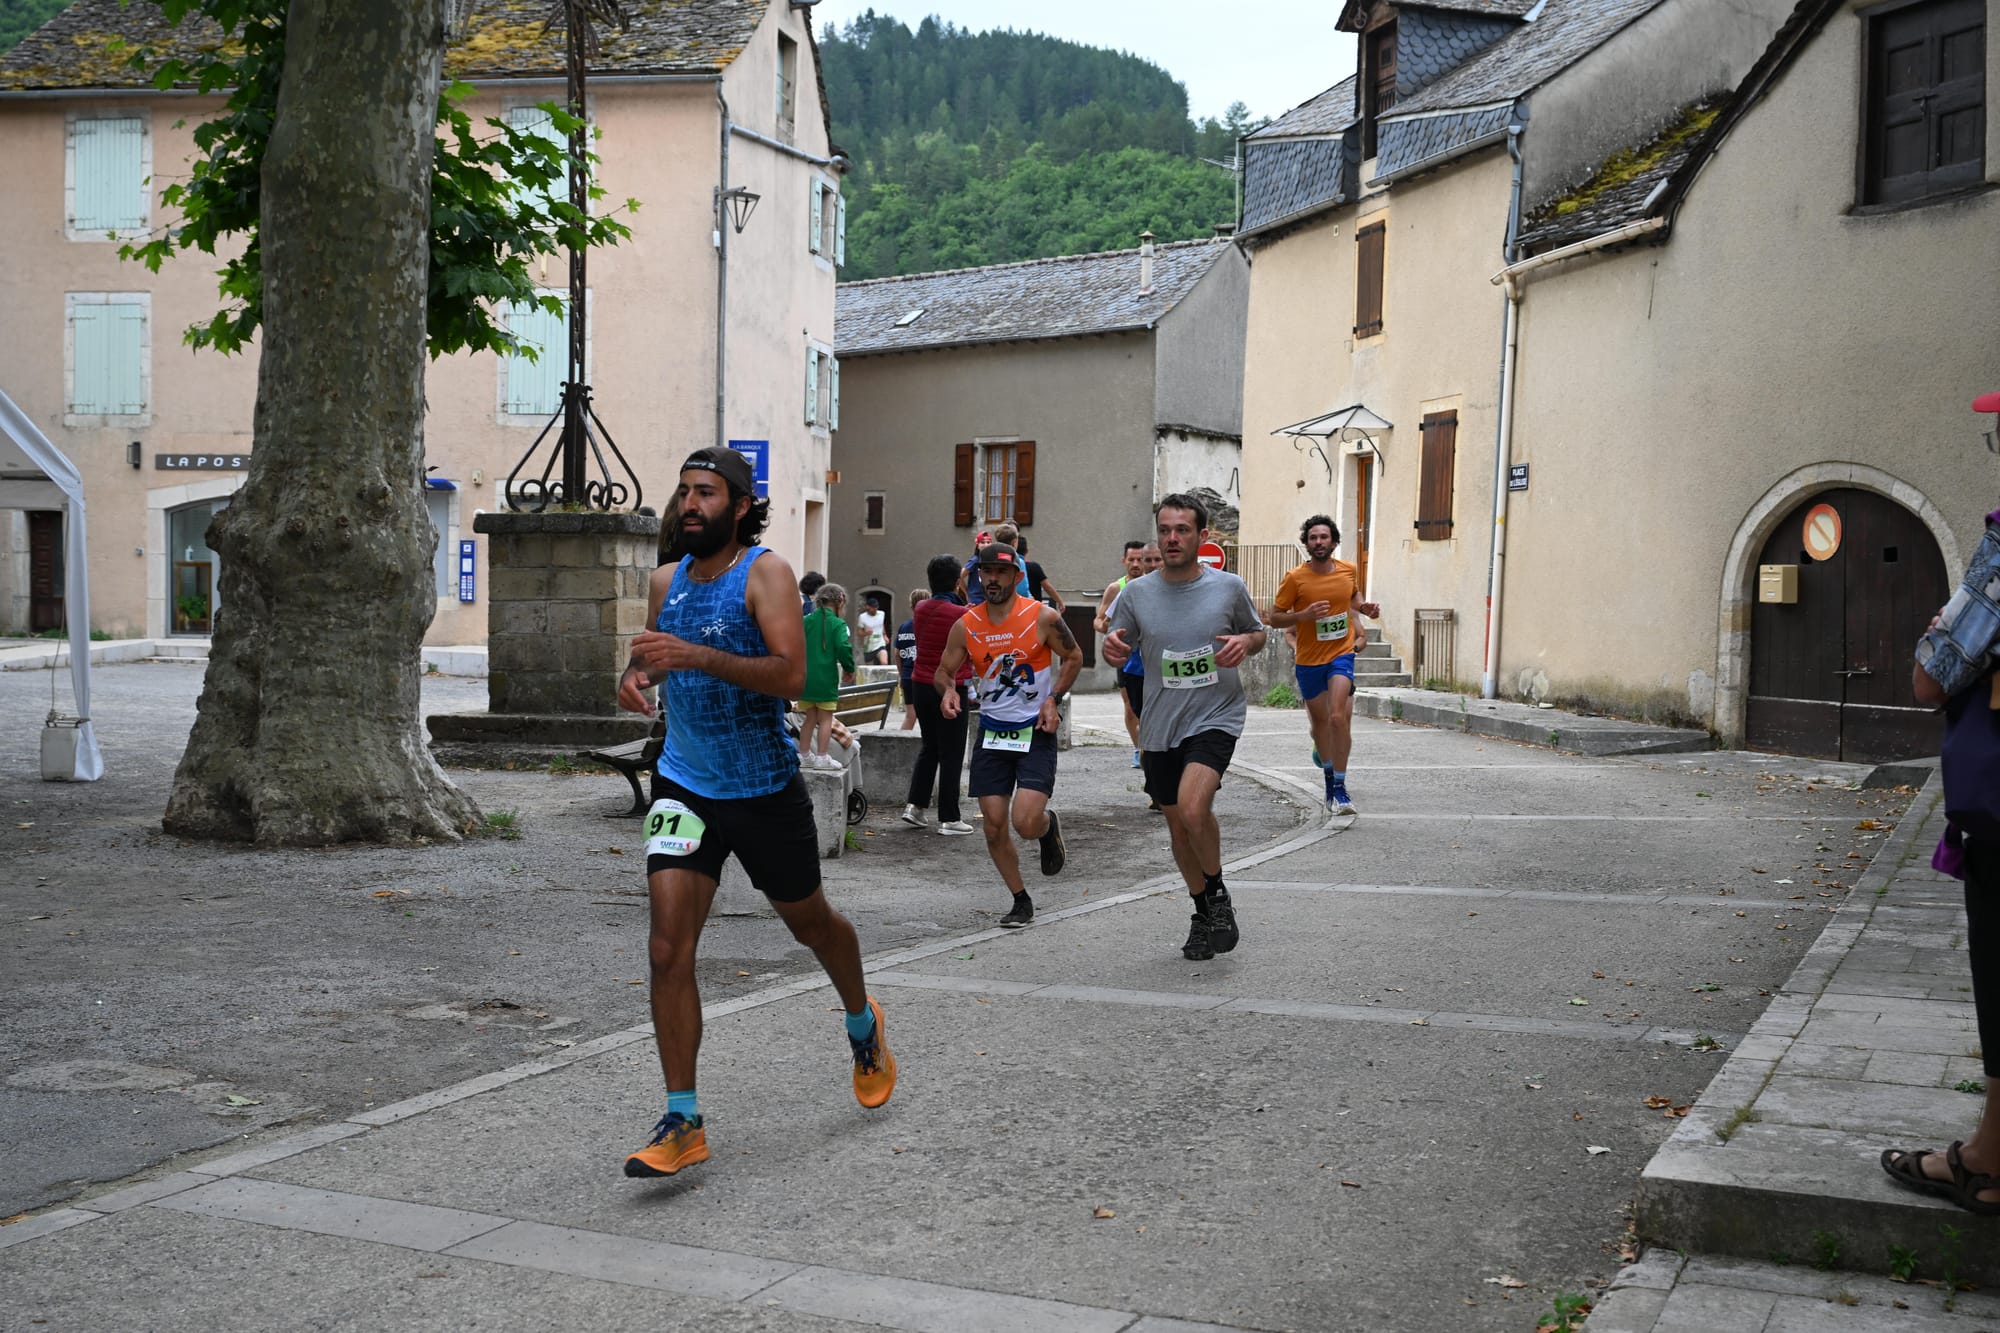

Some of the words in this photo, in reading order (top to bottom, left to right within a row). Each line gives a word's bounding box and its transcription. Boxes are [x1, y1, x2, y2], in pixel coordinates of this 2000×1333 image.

[166, 457, 189, 467] LA
[197, 457, 251, 467] POS
[1321, 620, 1345, 632] 132
[985, 632, 1014, 642] STRAVA
[1169, 658, 1209, 677] 136
[650, 813, 682, 836] 91
